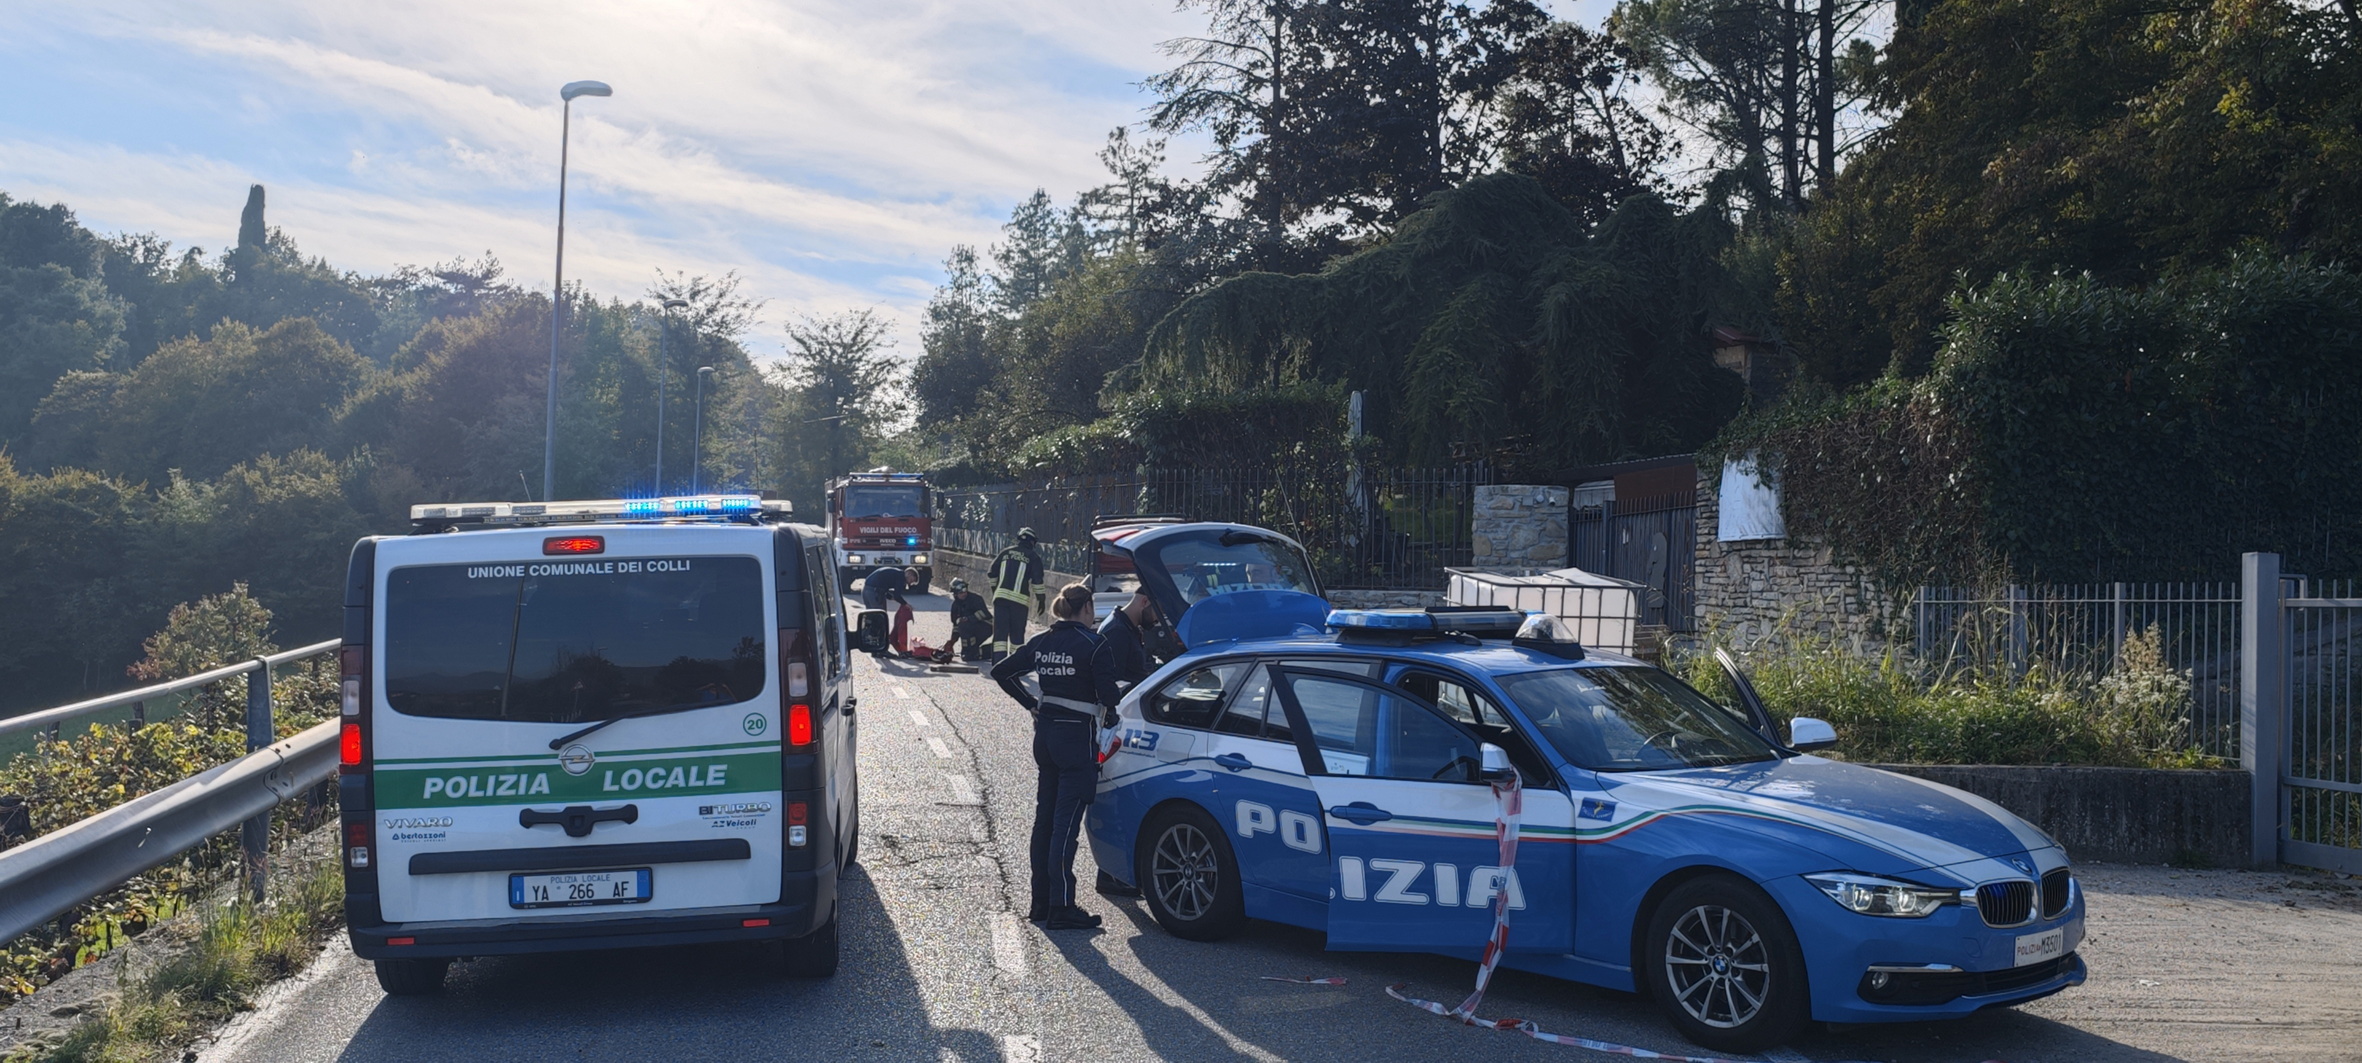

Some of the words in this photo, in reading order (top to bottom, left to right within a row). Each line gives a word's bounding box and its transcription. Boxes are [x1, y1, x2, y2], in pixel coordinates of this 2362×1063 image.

[467, 565, 525, 579] UNIONE
[529, 562, 614, 576] COMUNALE
[618, 561, 642, 573] DEI
[647, 560, 691, 572] COLLI
[1035, 651, 1073, 664] Polizia
[1036, 664, 1076, 676] Locale
[747, 718, 764, 731] 20
[1123, 728, 1159, 751] 113
[423, 772, 551, 799] POLIZIA
[603, 764, 728, 792] LOCALE
[384, 816, 453, 829] VIVARO
[726, 819, 757, 827] Veicoli
[401, 831, 446, 839] bertazzoni
[550, 876, 577, 884] POLIZIA
[582, 874, 611, 882] LOCALE
[1329, 855, 1527, 911] IZIA
[532, 885, 549, 902] YA
[569, 883, 594, 900] 266
[613, 881, 629, 898] AF
